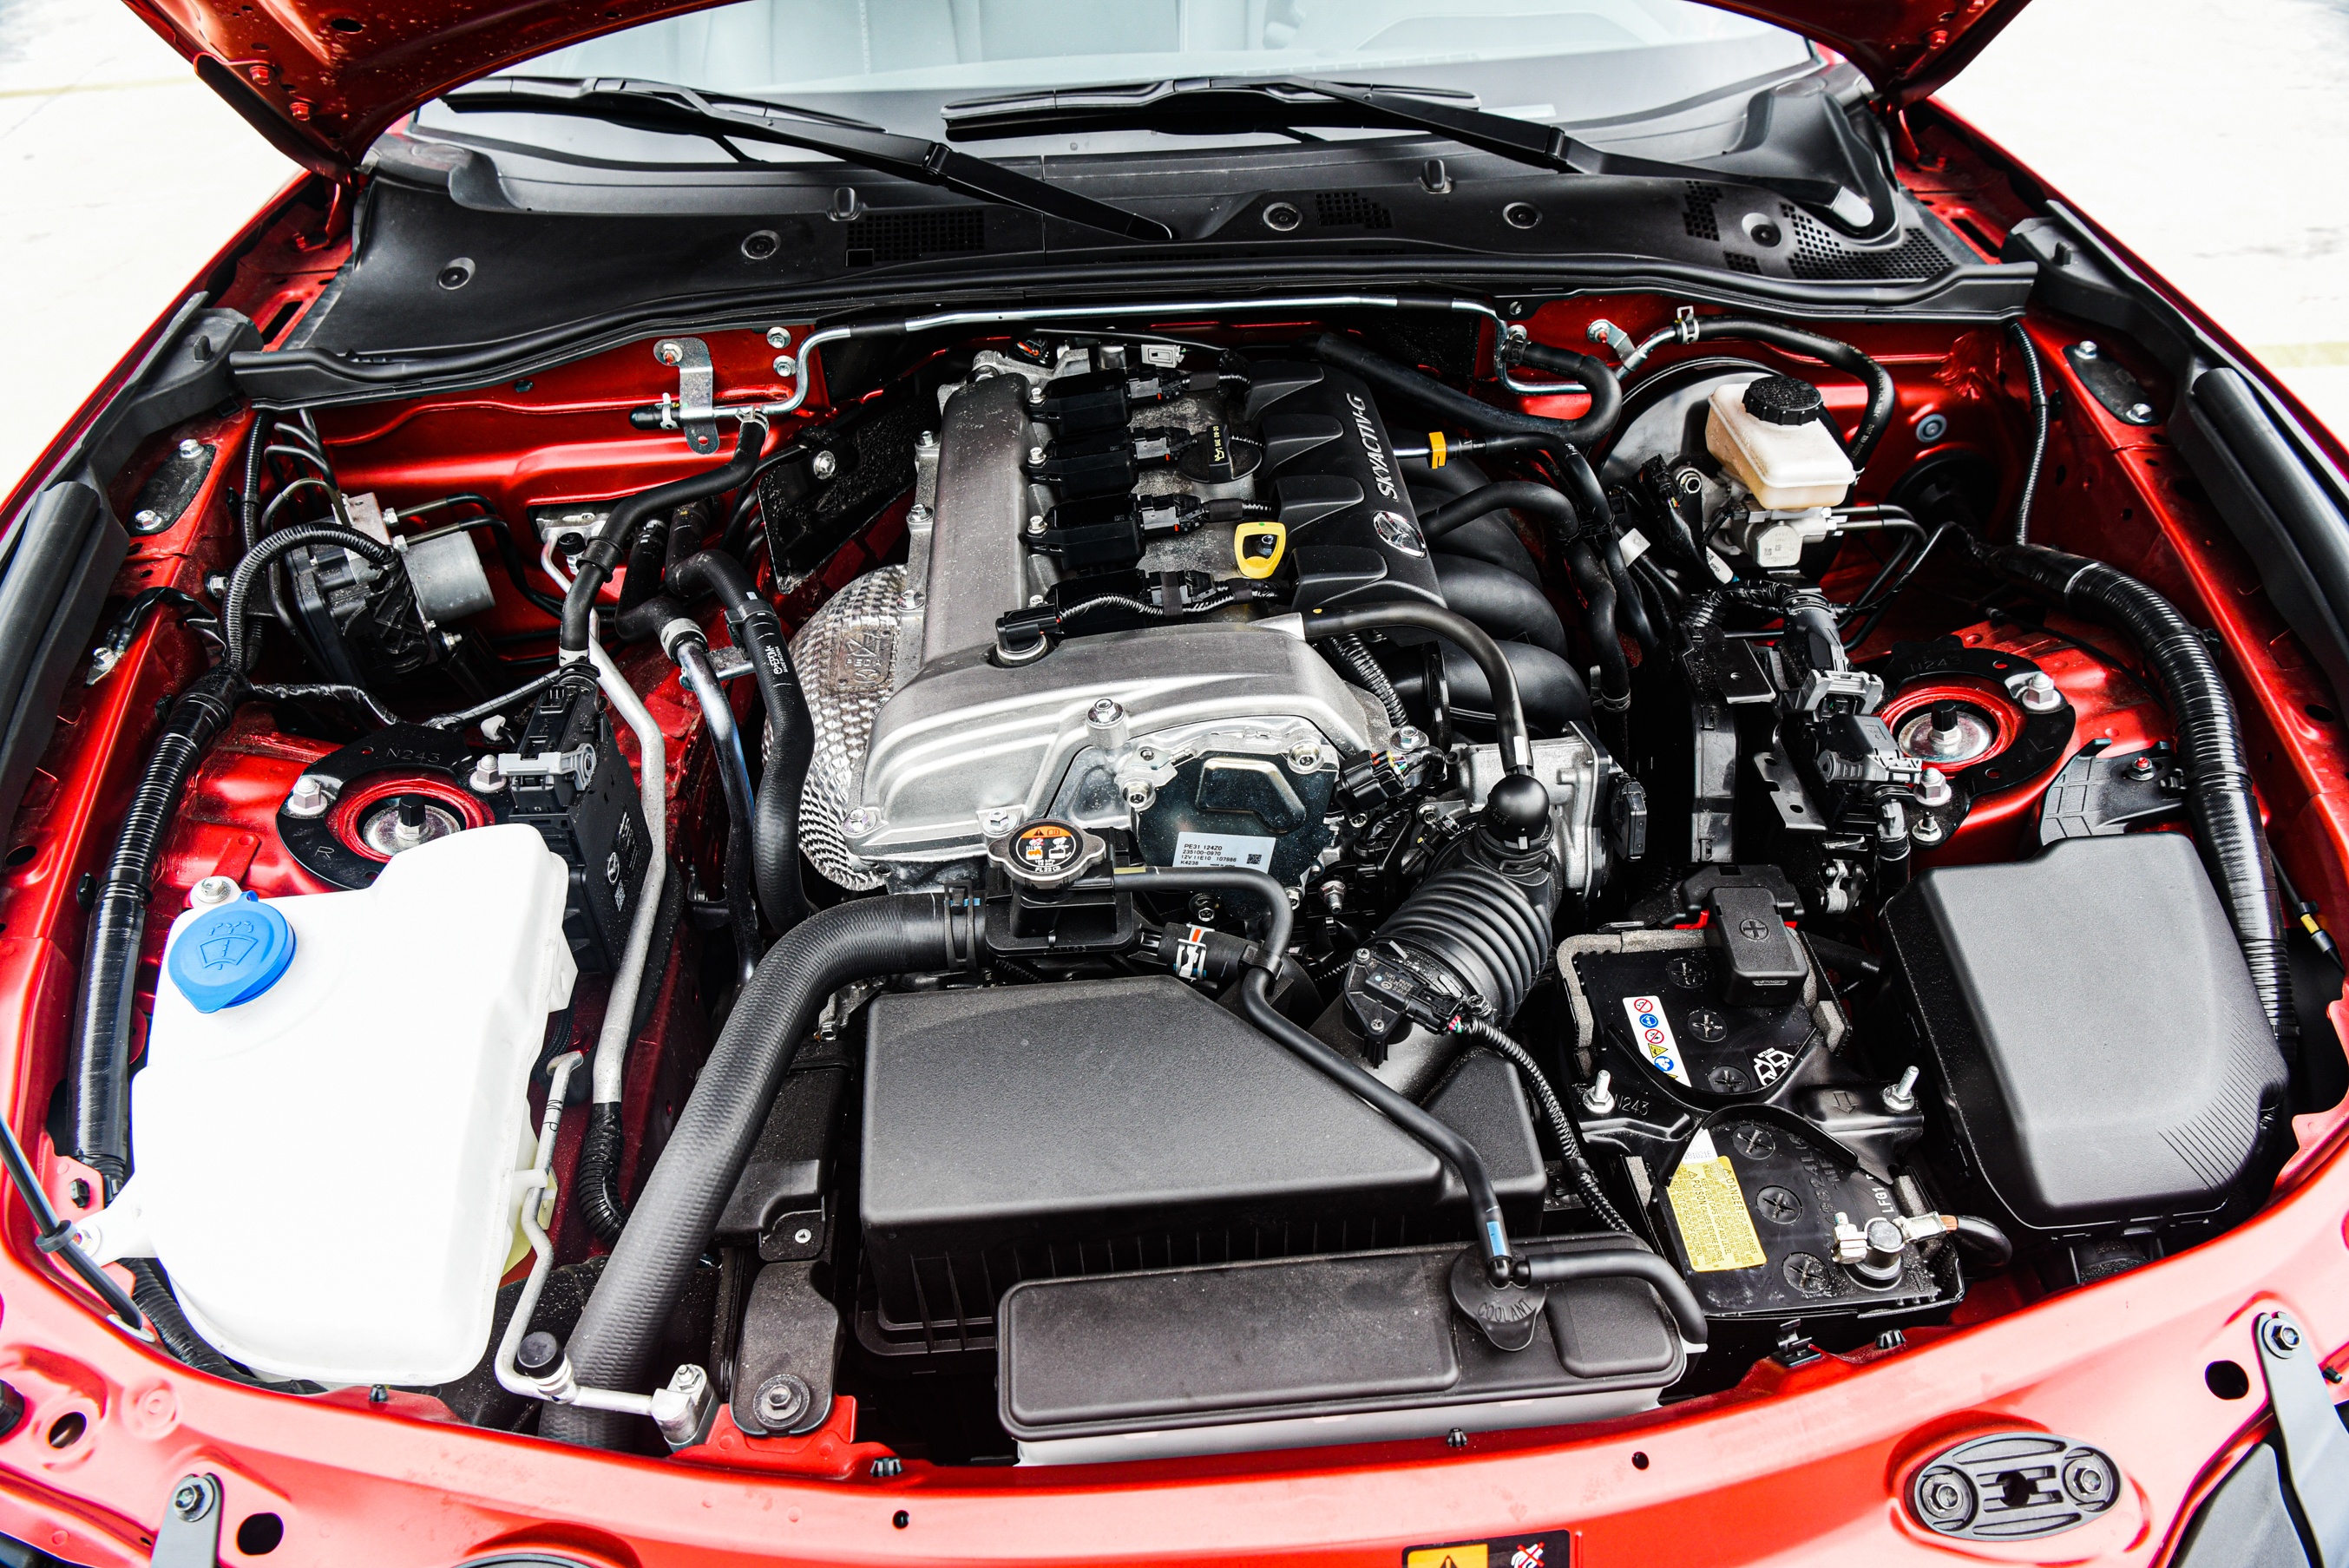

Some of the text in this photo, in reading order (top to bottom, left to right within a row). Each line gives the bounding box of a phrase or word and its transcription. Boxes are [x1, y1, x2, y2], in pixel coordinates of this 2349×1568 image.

[1346, 392, 1398, 501] SKYACTIV-G
[386, 747, 441, 764] N243
[314, 845, 335, 859] R
[1703, 1189, 1713, 1203] VENT
[1708, 1202, 1717, 1215] CAPS
[1726, 1178, 1757, 1254] DANGER EXPLOSIVE GASES
[1690, 1178, 1723, 1261] POISON CAUSES SEVERE BURNS
[1713, 1215, 1722, 1230] TIGHT
[1682, 1210, 1691, 1225] REACH
[1689, 1232, 1703, 1256] CHILDREN
[1717, 1230, 1726, 1240] AND
[1721, 1239, 1731, 1255] LEVEL
[1477, 1297, 1533, 1322] COOLANT
